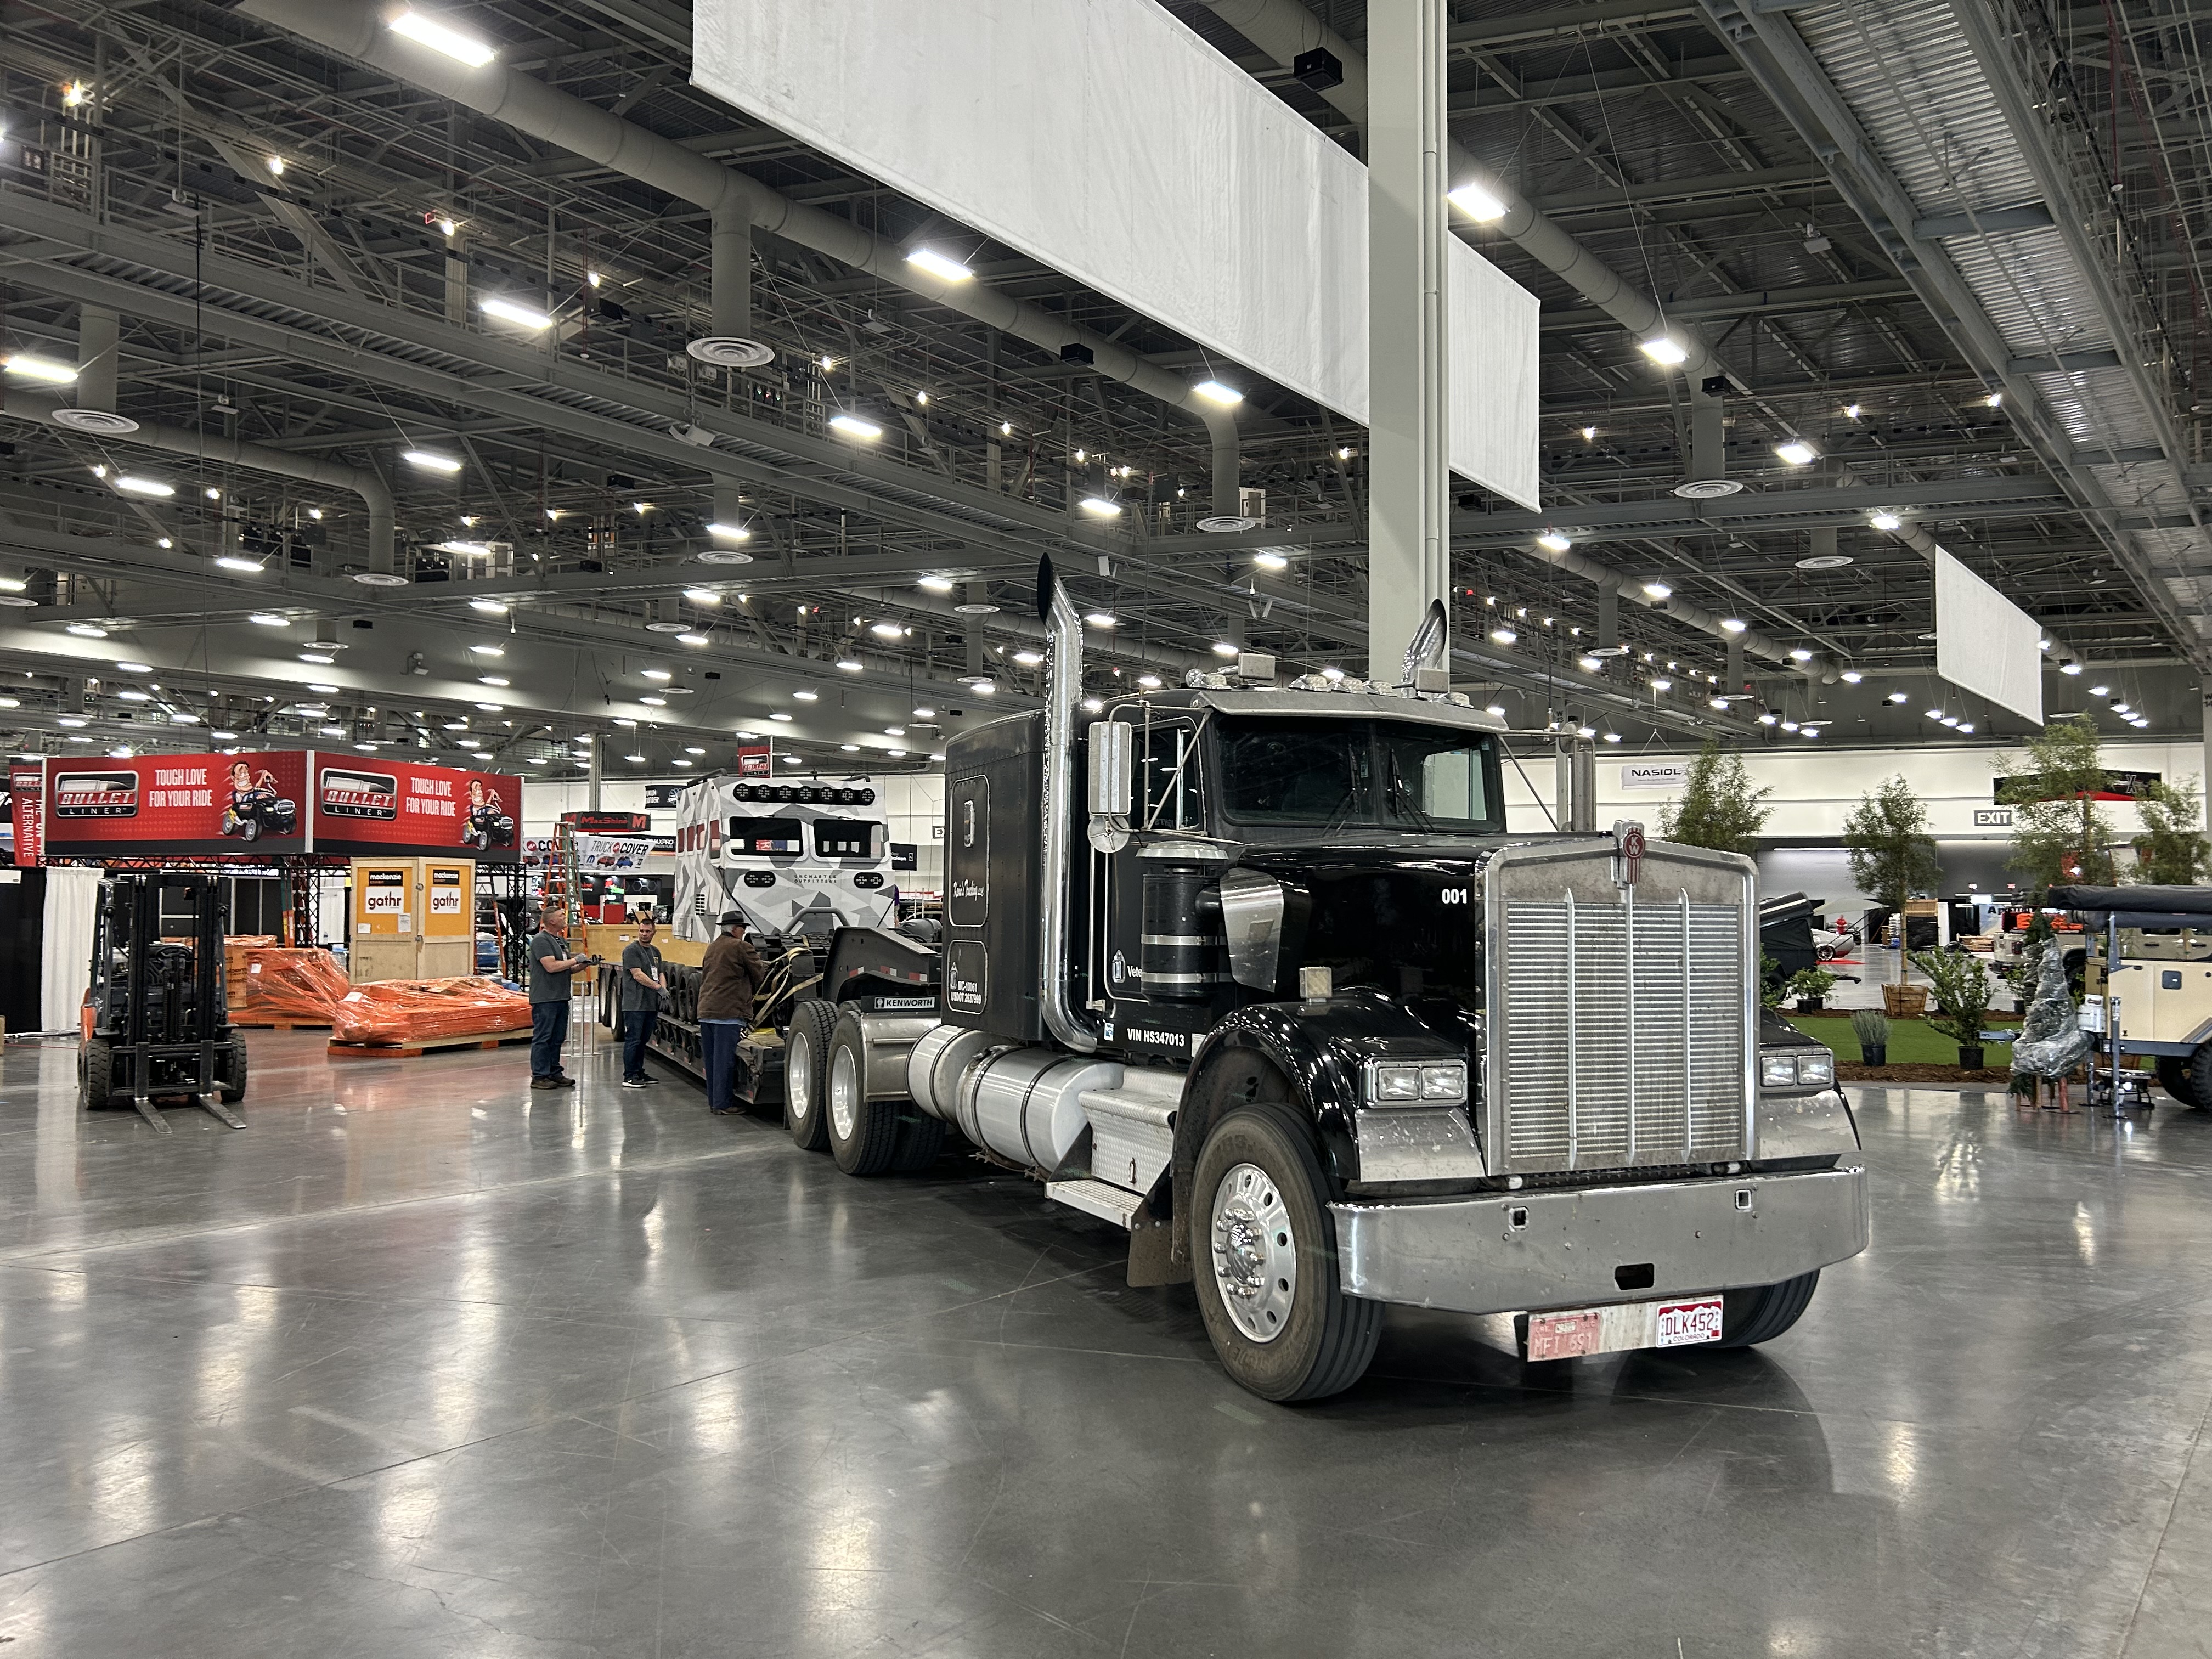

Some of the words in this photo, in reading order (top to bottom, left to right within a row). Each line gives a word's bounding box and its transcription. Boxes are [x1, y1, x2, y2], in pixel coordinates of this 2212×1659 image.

[155, 769, 184, 786] TOUGH
[186, 769, 207, 785] LOVE
[410, 777, 433, 794] TOUGH
[435, 781, 453, 797] LOVE
[60, 793, 133, 804] BULLET
[149, 791, 166, 807] FOR
[167, 791, 191, 807] YOUR
[193, 790, 213, 806] RIDE
[326, 791, 393, 806] BULLET
[406, 797, 421, 813] FOR
[421, 799, 441, 815] YOUR
[441, 802, 456, 816] RIDE
[335, 806, 383, 816] LINER
[1977, 812, 2010, 823] EXIT
[22, 798, 34, 857] ALTERNATIVE
[591, 840, 616, 853] TRUCK
[619, 843, 648, 855] COVER
[368, 891, 402, 910] gathr
[433, 892, 459, 910] gathr
[1442, 889, 1467, 904] 001
[1127, 1028, 1142, 1042] VIN
[1143, 1030, 1184, 1047] HS347013
[1666, 1312, 1714, 1335] DLK452
[1673, 1333, 1705, 1341] COLORADO
